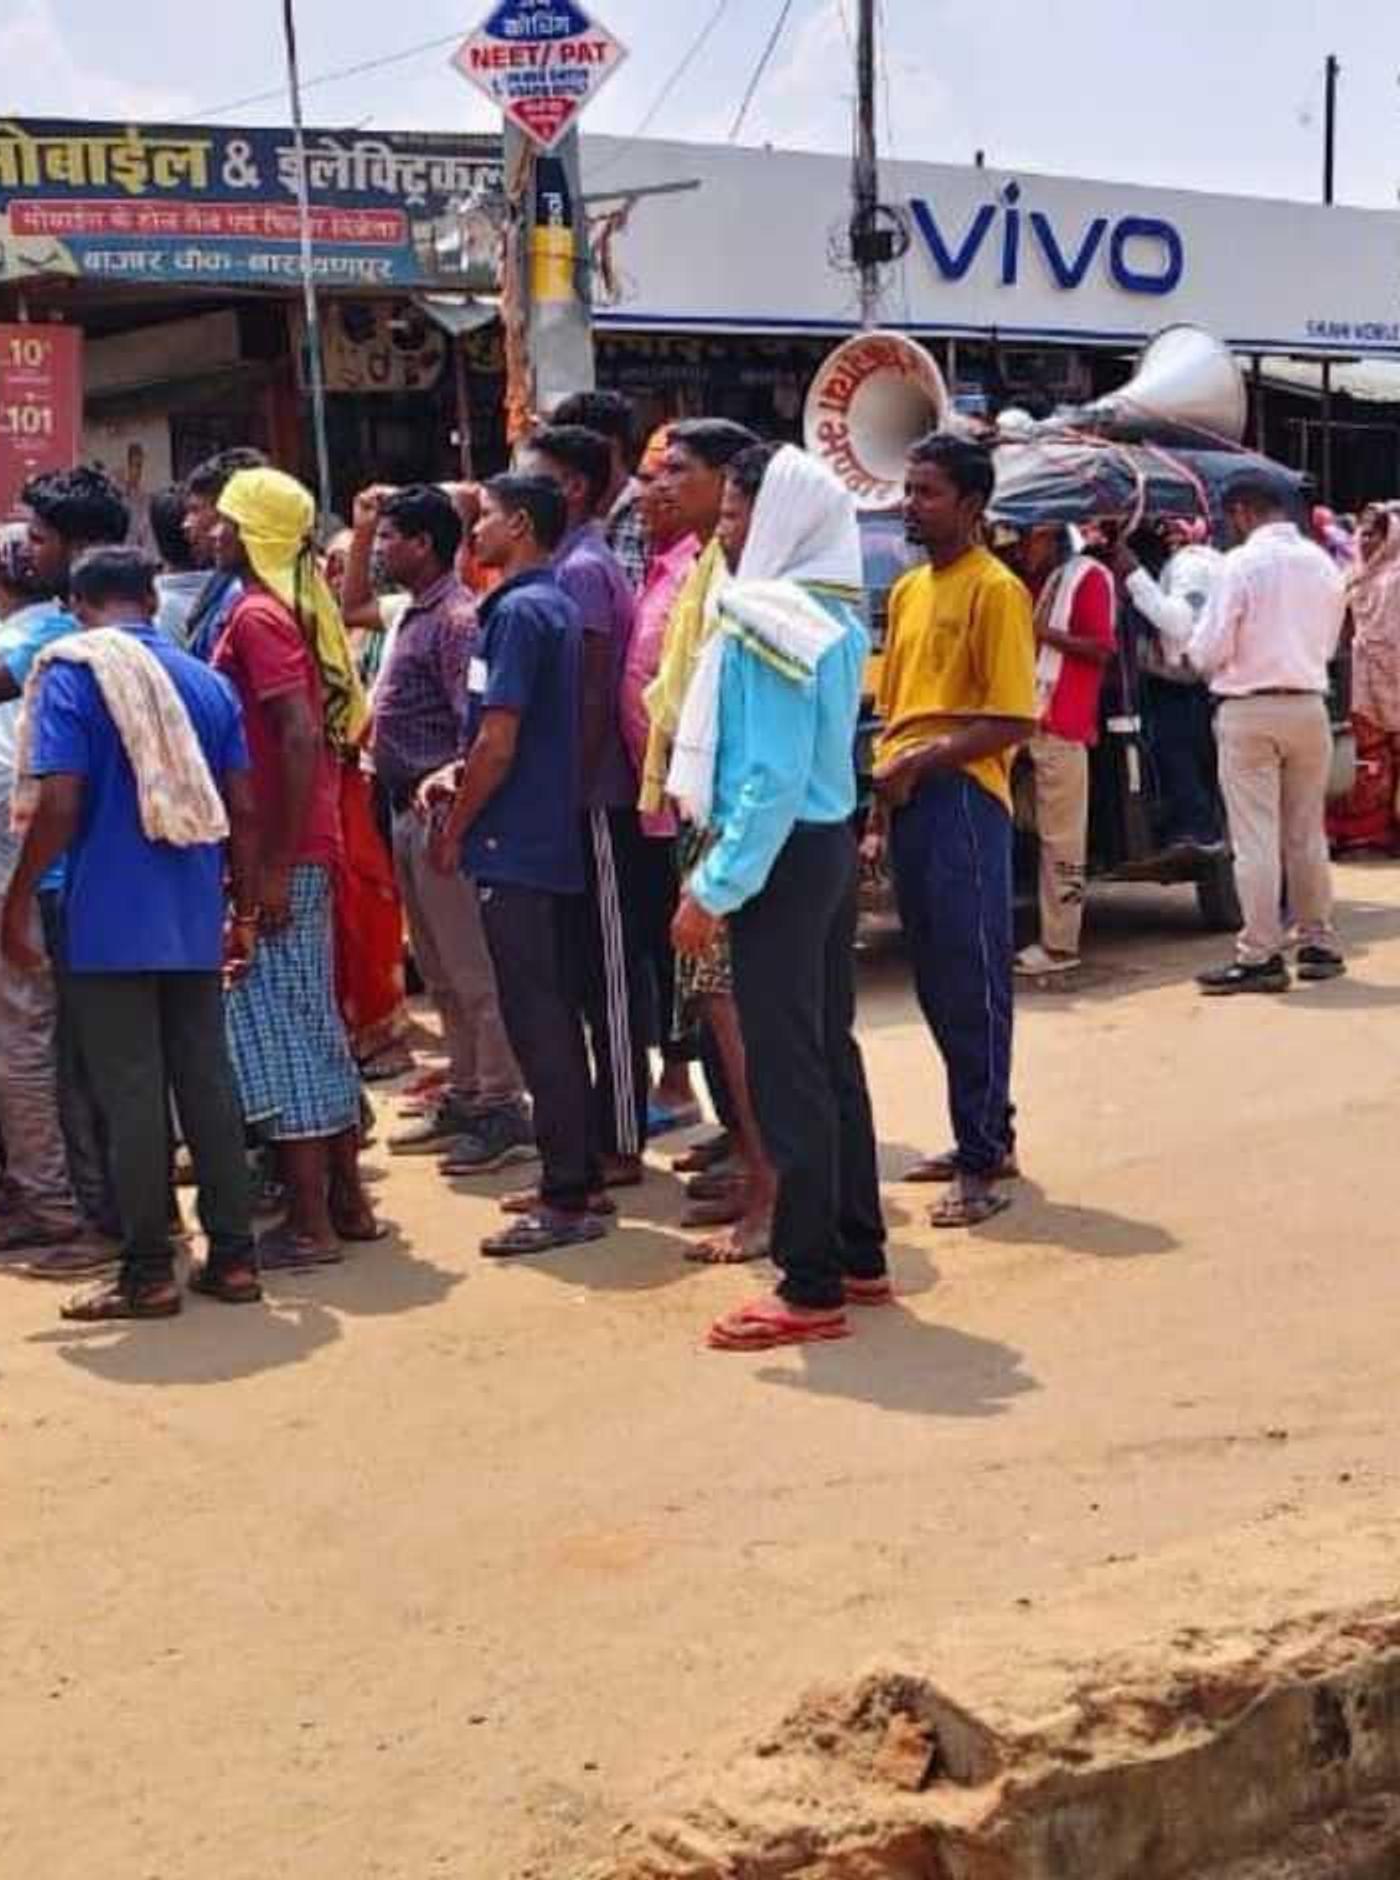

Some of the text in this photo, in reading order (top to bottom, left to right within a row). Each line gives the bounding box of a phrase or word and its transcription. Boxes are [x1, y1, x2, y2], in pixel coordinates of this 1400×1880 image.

[559, 42, 606, 64] PAT
[222, 138, 261, 189] &
[909, 181, 1184, 295] vivo
